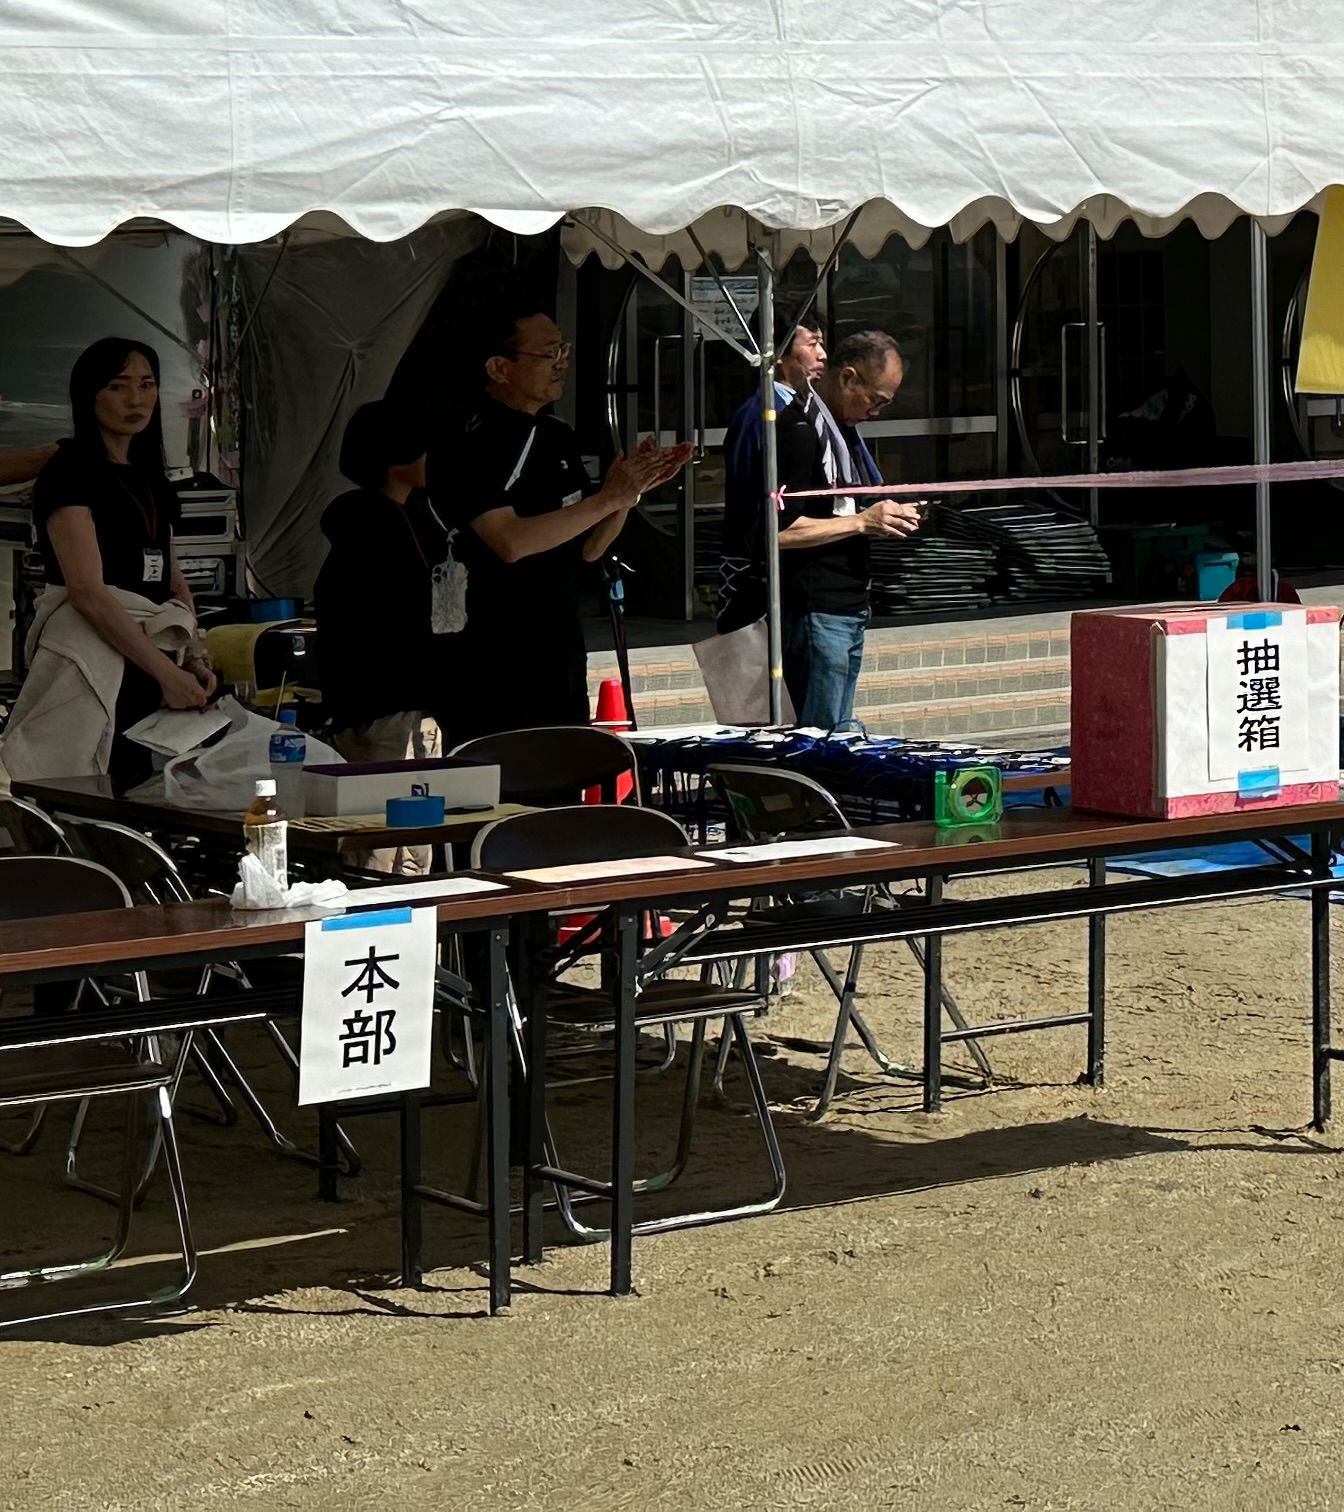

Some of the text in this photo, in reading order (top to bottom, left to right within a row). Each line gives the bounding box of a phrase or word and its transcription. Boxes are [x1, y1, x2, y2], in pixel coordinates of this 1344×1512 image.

[1235, 637, 1283, 753] 抽選箱
[338, 944, 400, 1068] 本部
